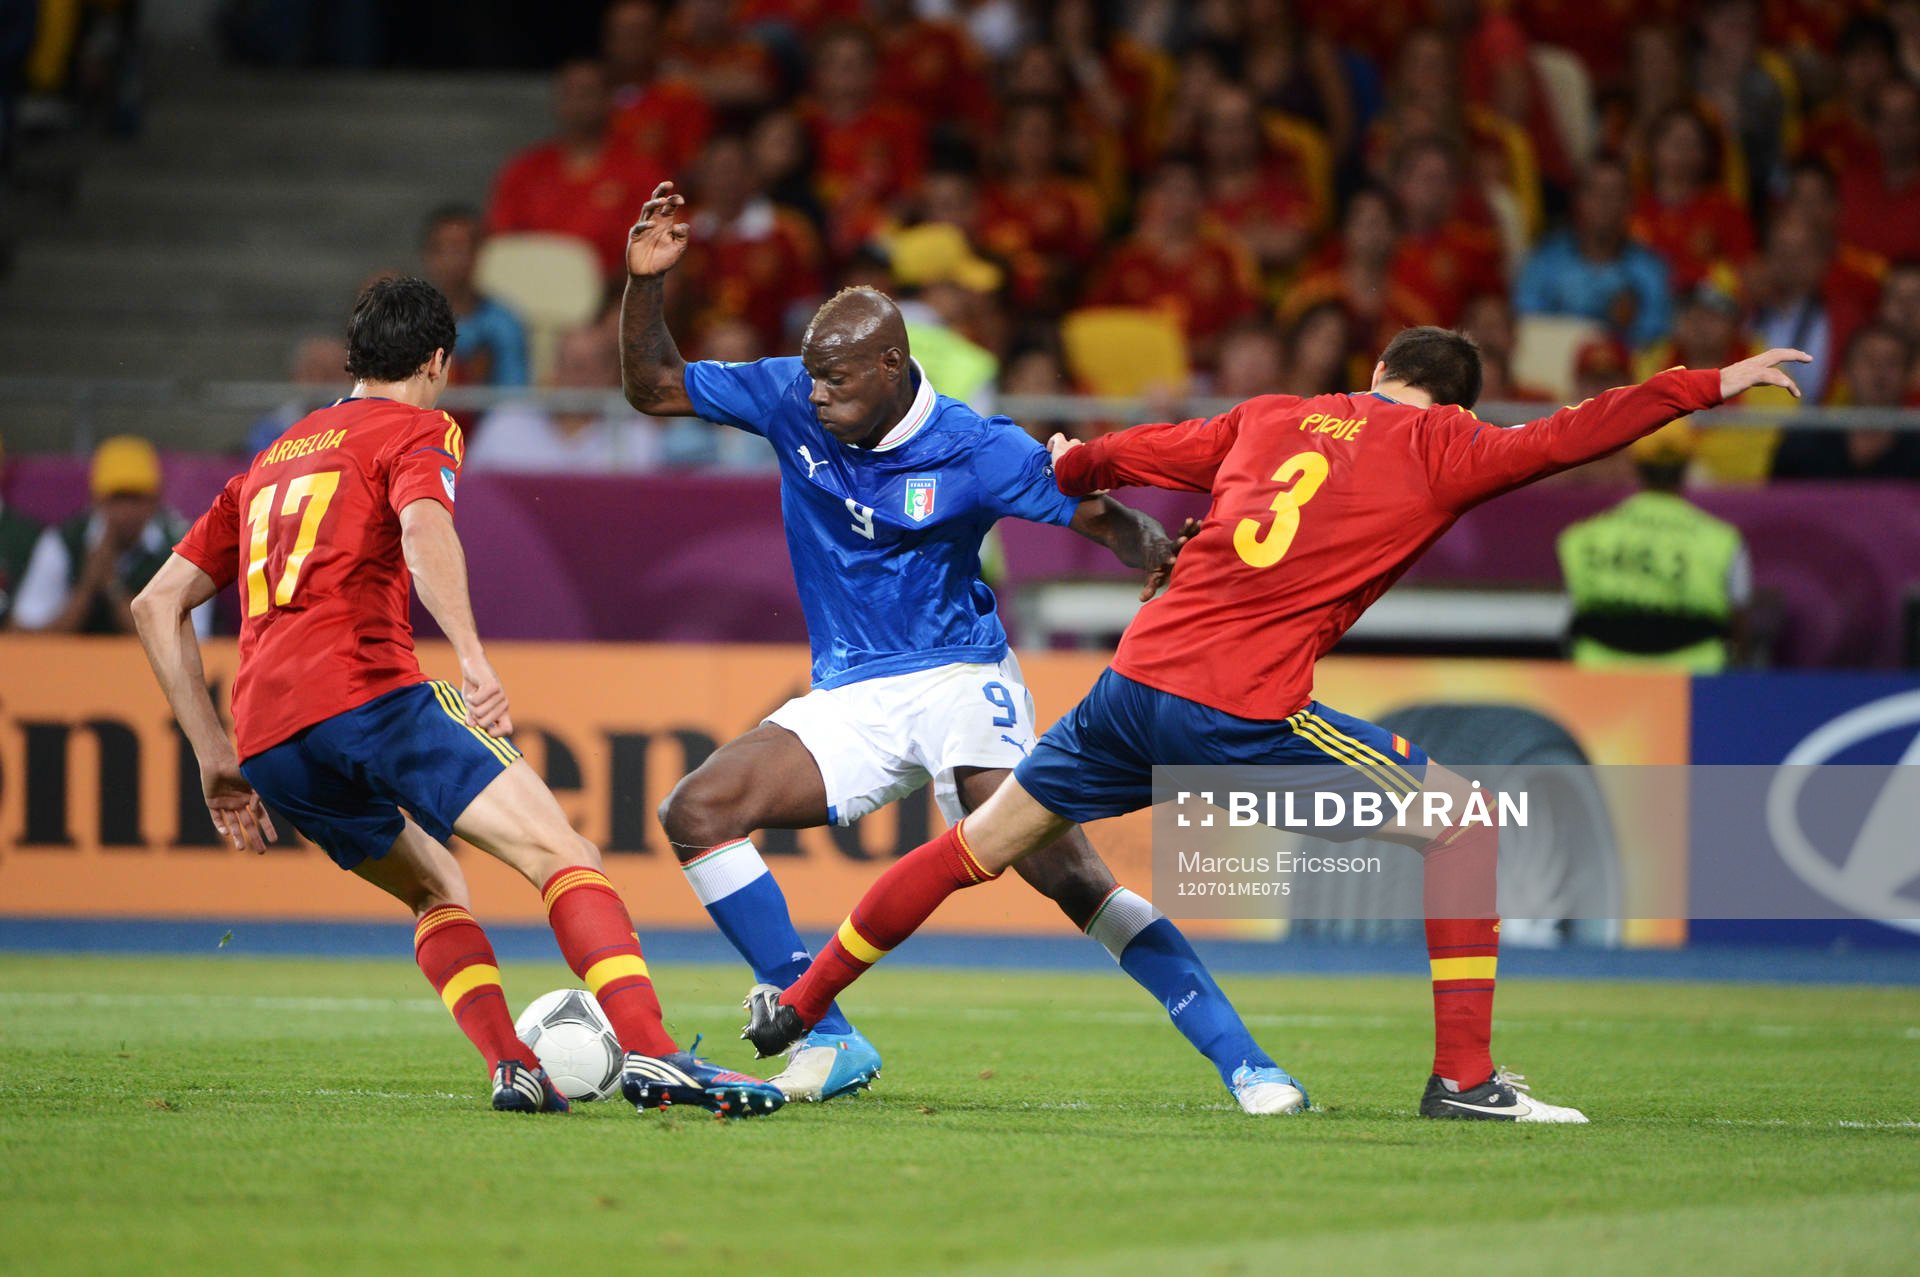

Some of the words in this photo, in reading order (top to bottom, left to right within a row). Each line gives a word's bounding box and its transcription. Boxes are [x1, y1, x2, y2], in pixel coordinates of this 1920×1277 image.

[261, 428, 348, 467] ARBELOA
[1300, 413, 1368, 442] PIQUÉ
[845, 498, 875, 540] 9
[1233, 451, 1329, 568] 3
[247, 470, 341, 619] 17
[982, 681, 1017, 728] 9
[1170, 990, 1198, 1017] ITALIA
